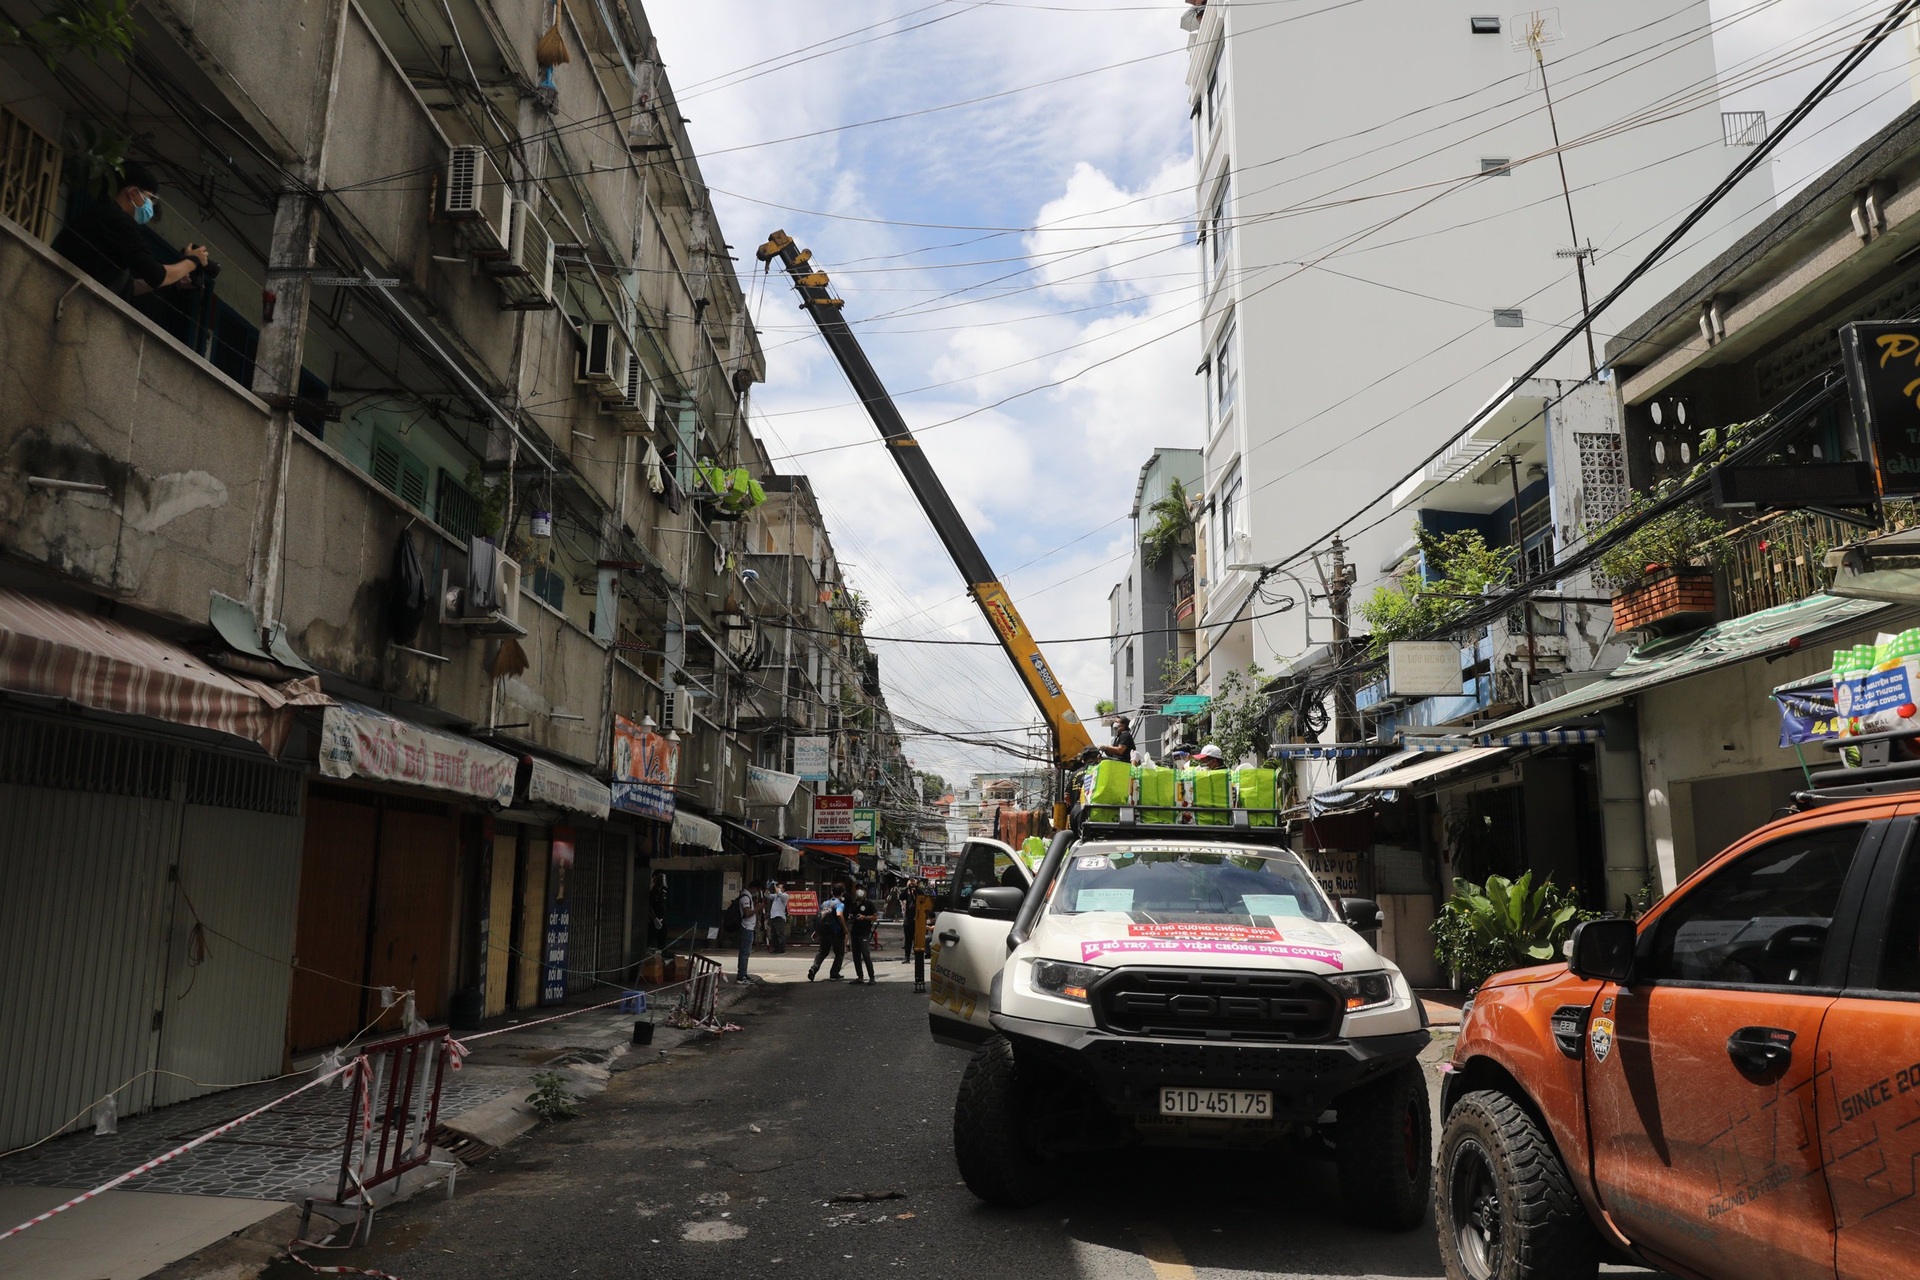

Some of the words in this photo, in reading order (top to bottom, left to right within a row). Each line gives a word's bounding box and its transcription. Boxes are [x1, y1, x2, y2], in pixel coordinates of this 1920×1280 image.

[1876, 333, 1920, 369] P
[1906, 428, 1920, 443] T
[1040, 667, 1059, 695] SOOSAN
[1879, 692, 1906, 705] COVID-19
[357, 726, 400, 775] BÚN
[402, 737, 429, 781] BÒ
[433, 748, 466, 788] HUẾ
[1335, 876, 1357, 894] Ruột
[1178, 924, 1212, 932] CƯỜNG
[1214, 924, 1249, 934] CHỐNG
[1250, 928, 1276, 937] DỊCH
[1085, 943, 1100, 955] XE
[1153, 939, 1180, 949] TIẾP
[1182, 939, 1213, 952] VIỆN
[1215, 940, 1257, 952] CHỐNG
[1259, 945, 1288, 956] DỊCH
[1290, 947, 1343, 964] COVID-19
[935, 964, 951, 979] SINCE
[951, 970, 966, 986] 2020
[1114, 990, 1317, 1021] FORD
[1164, 1090, 1267, 1114] 51D-451.75
[1841, 1077, 1893, 1122] SINCE
[1707, 1192, 1747, 1220] RACING
[1747, 1164, 1793, 1202] OFFROAD
